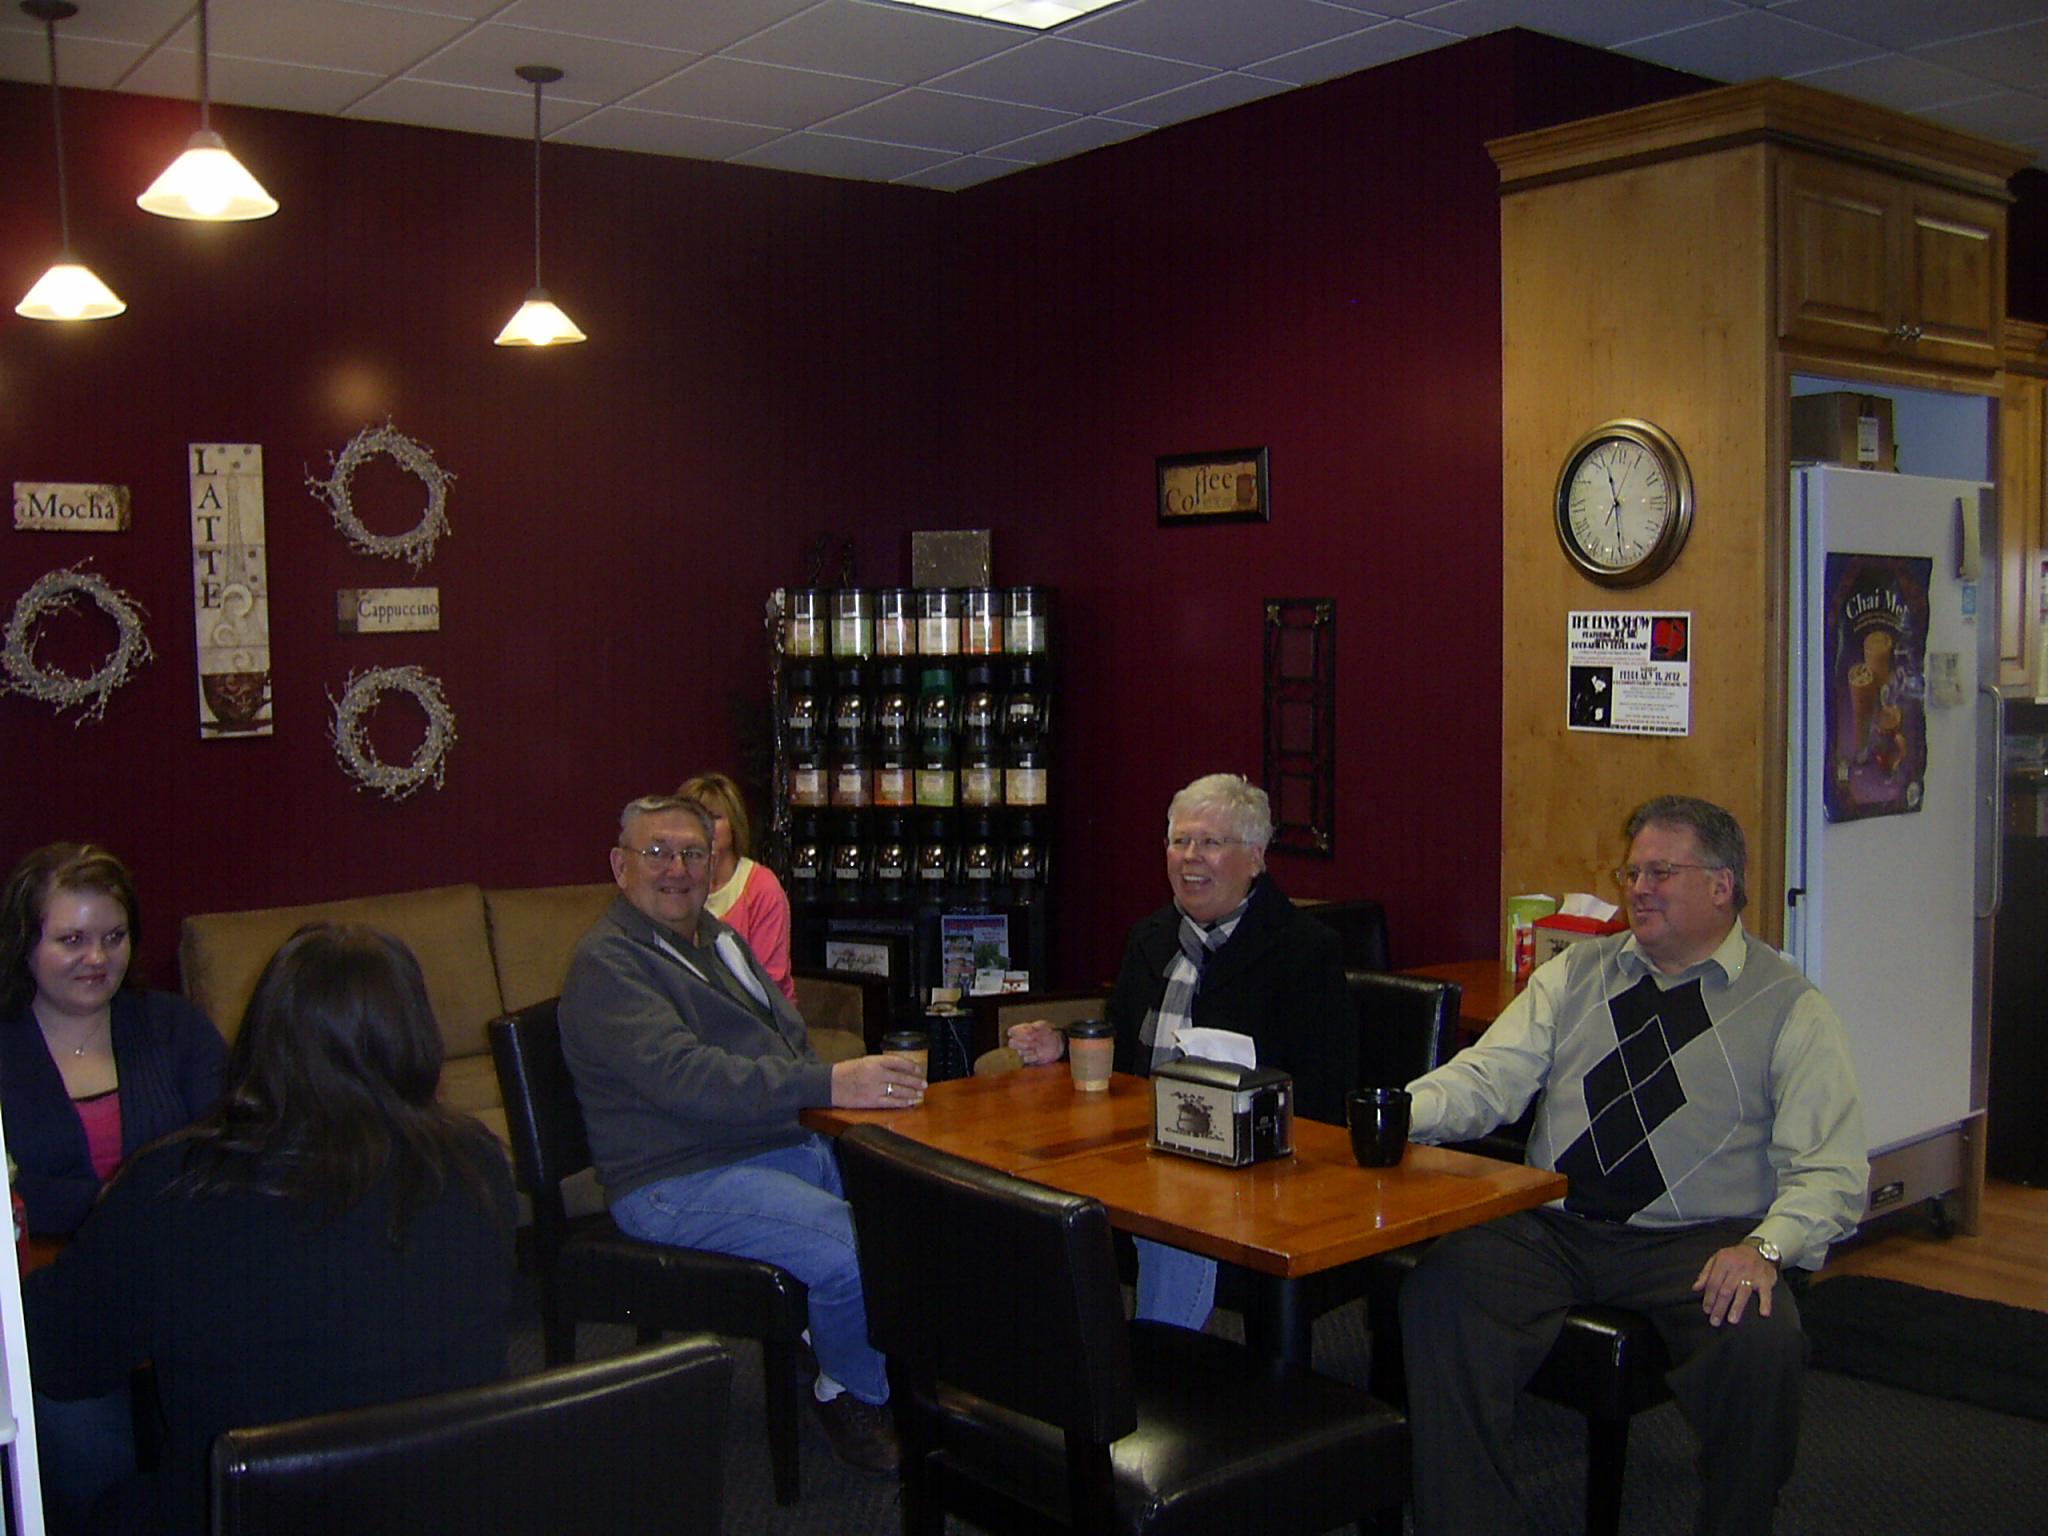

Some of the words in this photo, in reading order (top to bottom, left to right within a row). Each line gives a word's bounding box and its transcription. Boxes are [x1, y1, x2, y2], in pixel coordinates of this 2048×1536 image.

[1165, 464, 1233, 514] Coffee
[26, 491, 116, 521] Mocha
[195, 447, 224, 610] LATTE
[357, 597, 439, 628] Cappuccino
[1845, 588, 1879, 619] Chai
[1572, 615, 1590, 629] THE
[1592, 615, 1620, 629] ELVIS
[1622, 615, 1650, 630] SHOW
